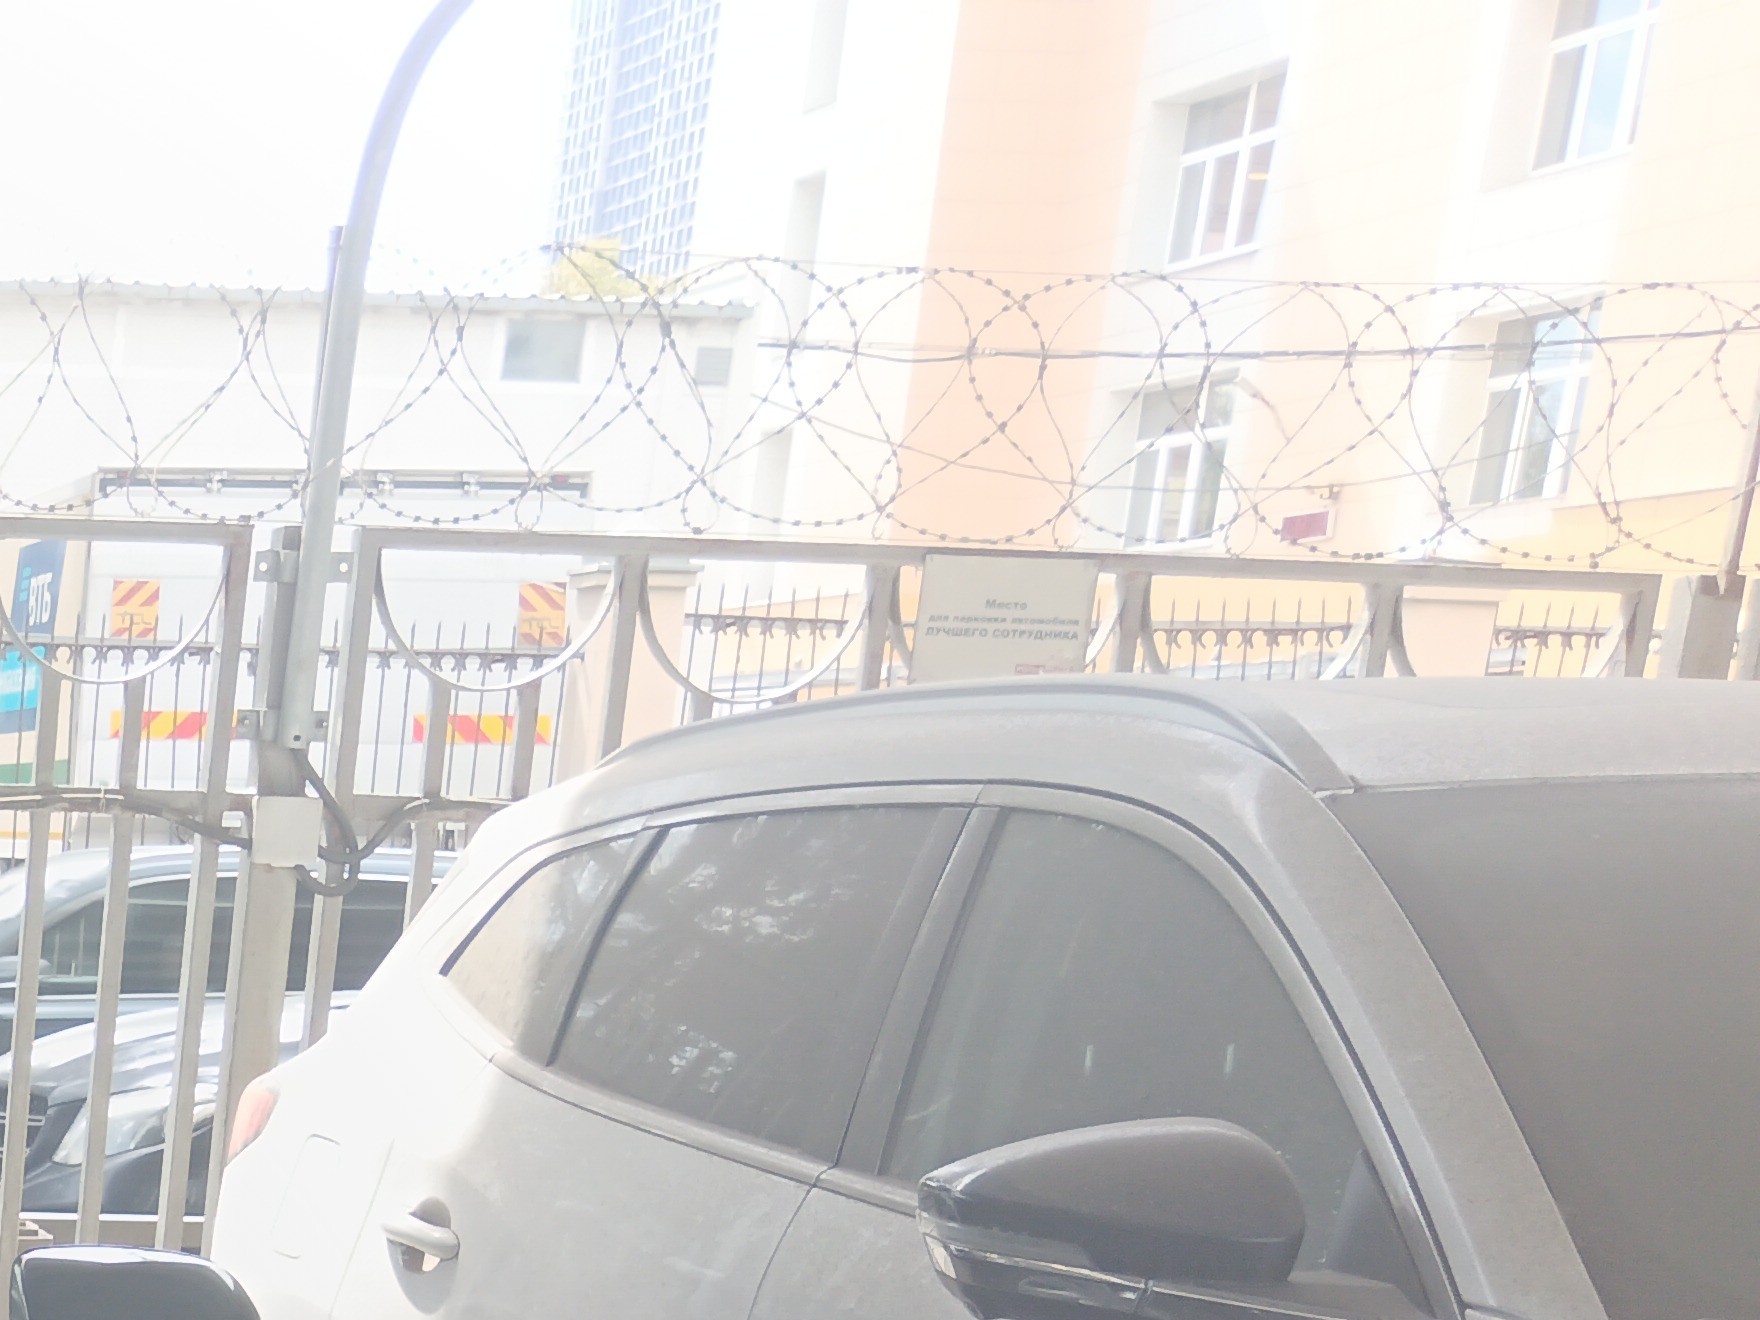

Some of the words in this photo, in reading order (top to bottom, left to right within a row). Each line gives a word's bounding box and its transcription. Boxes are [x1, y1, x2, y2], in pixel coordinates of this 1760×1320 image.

[28, 572, 53, 627] ВТБ
[985, 599, 1028, 611] Место
[925, 626, 989, 638] ЛУЧШЕГО
[992, 628, 1079, 641] СОТРУДНИКА
